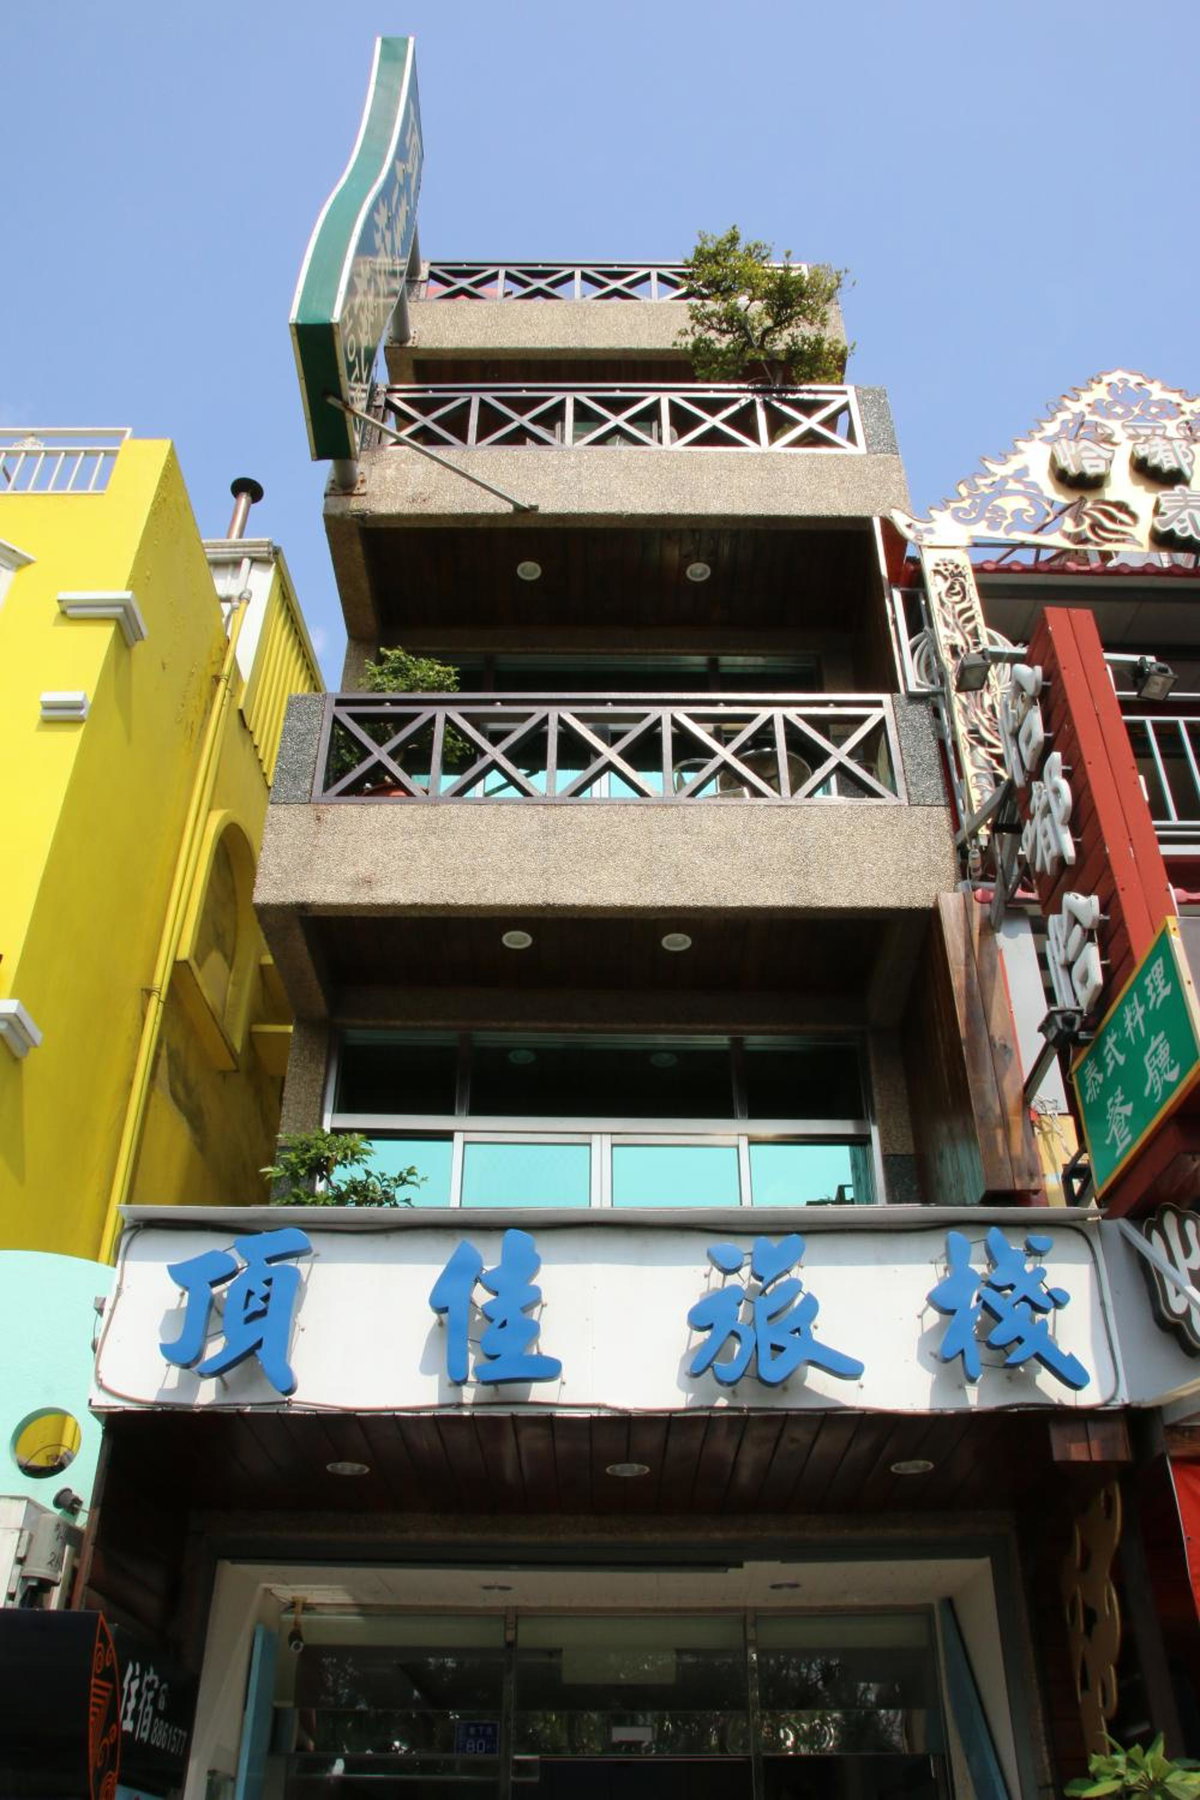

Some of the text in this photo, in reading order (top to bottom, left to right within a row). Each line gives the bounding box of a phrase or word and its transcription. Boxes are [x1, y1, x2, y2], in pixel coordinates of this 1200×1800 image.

[1084, 956, 1172, 1104] 泰式料理
[1105, 1031, 1182, 1158] 餐廳
[159, 1226, 1091, 1396] 頂佳旅棧
[119, 1660, 160, 1744] 住宿
